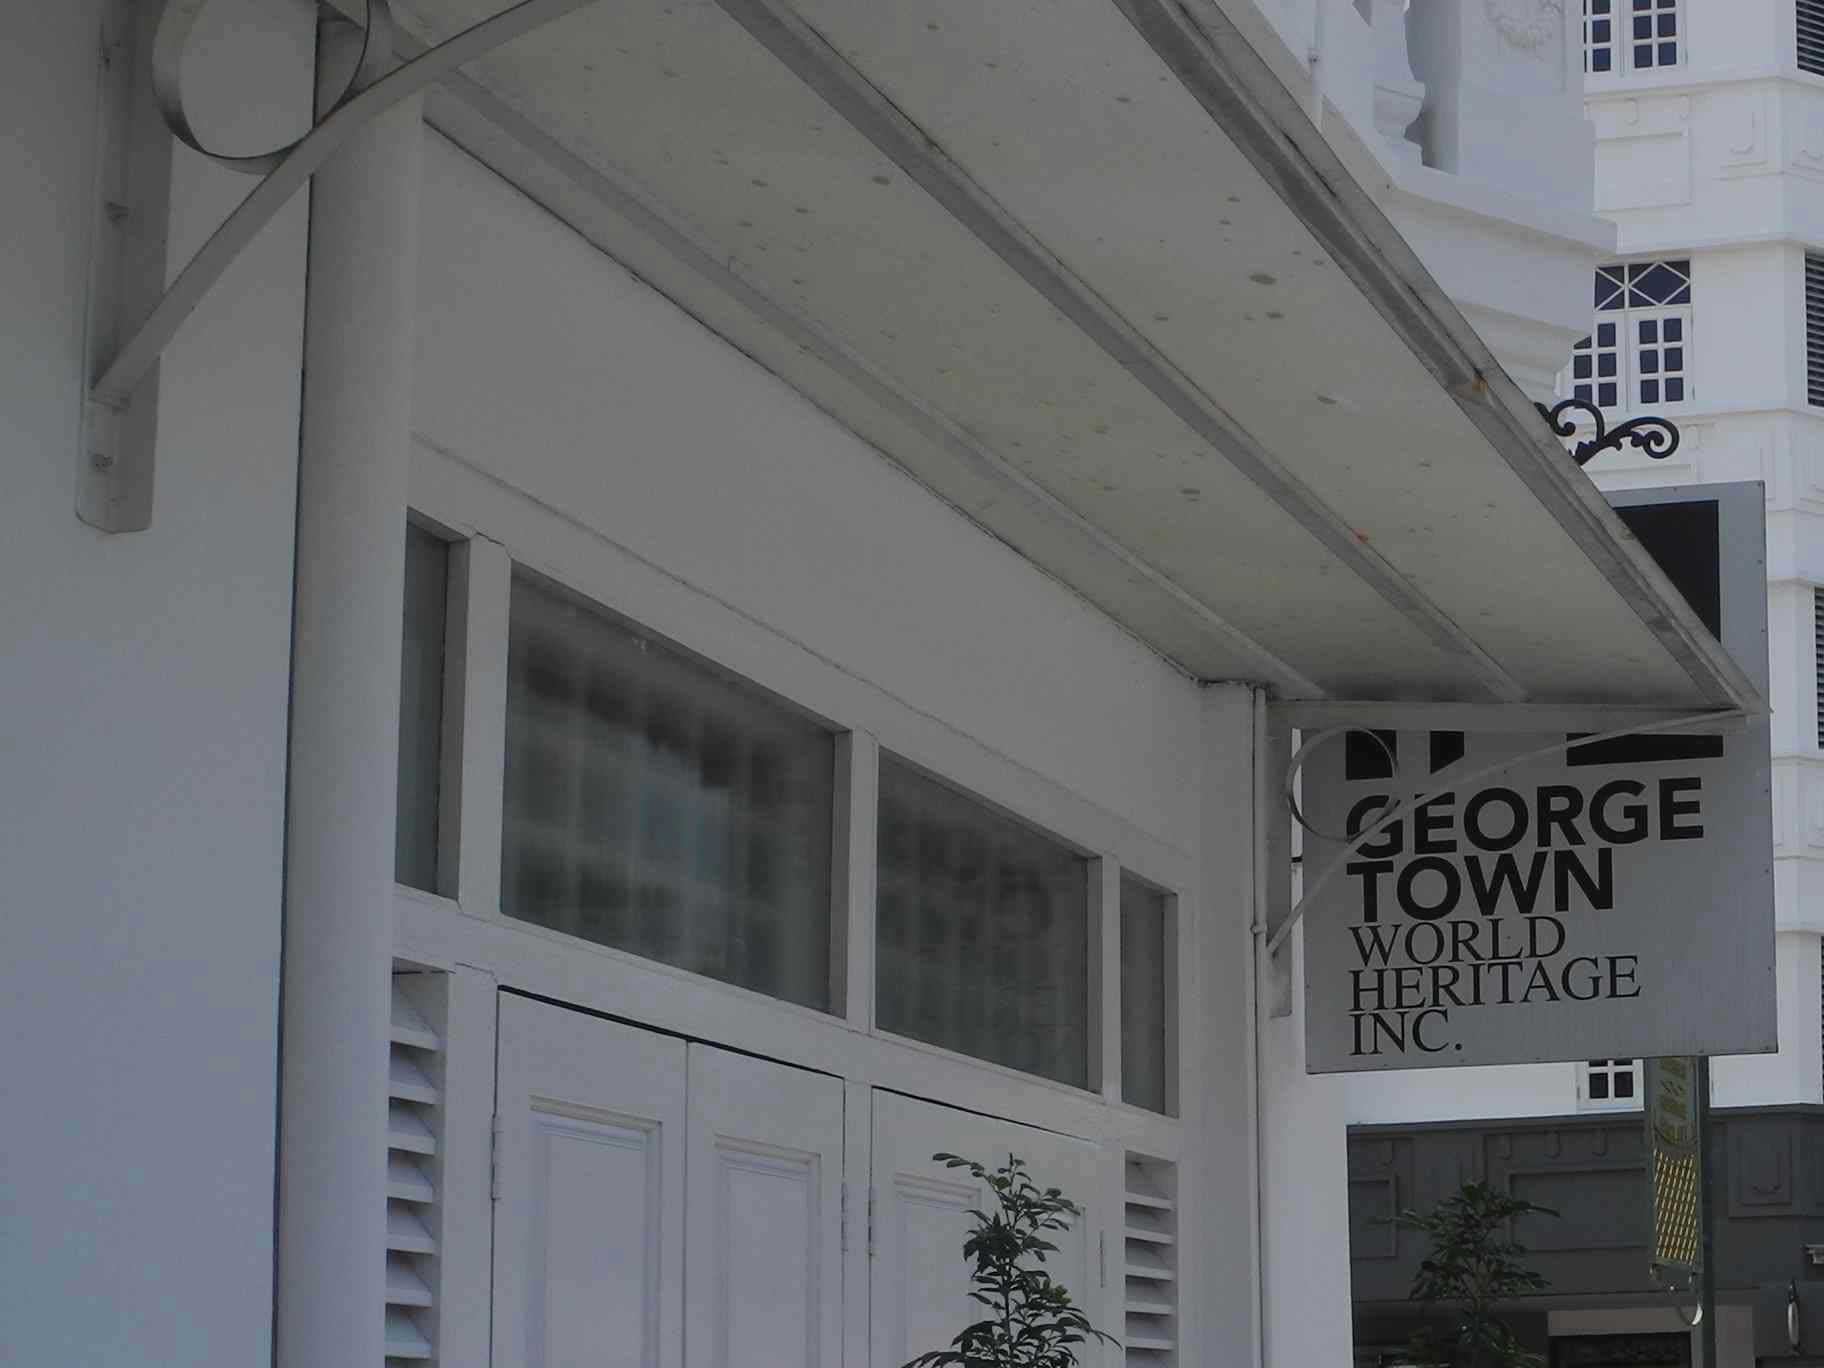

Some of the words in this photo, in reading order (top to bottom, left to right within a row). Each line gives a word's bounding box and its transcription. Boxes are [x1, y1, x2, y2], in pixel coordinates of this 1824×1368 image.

[1345, 776, 1704, 860] GEORGE
[1346, 847, 1614, 922] TOWN
[1348, 915, 1567, 967] WORLD
[1348, 955, 1642, 1013] HERITAGE
[1349, 1008, 1463, 1056] INC.
